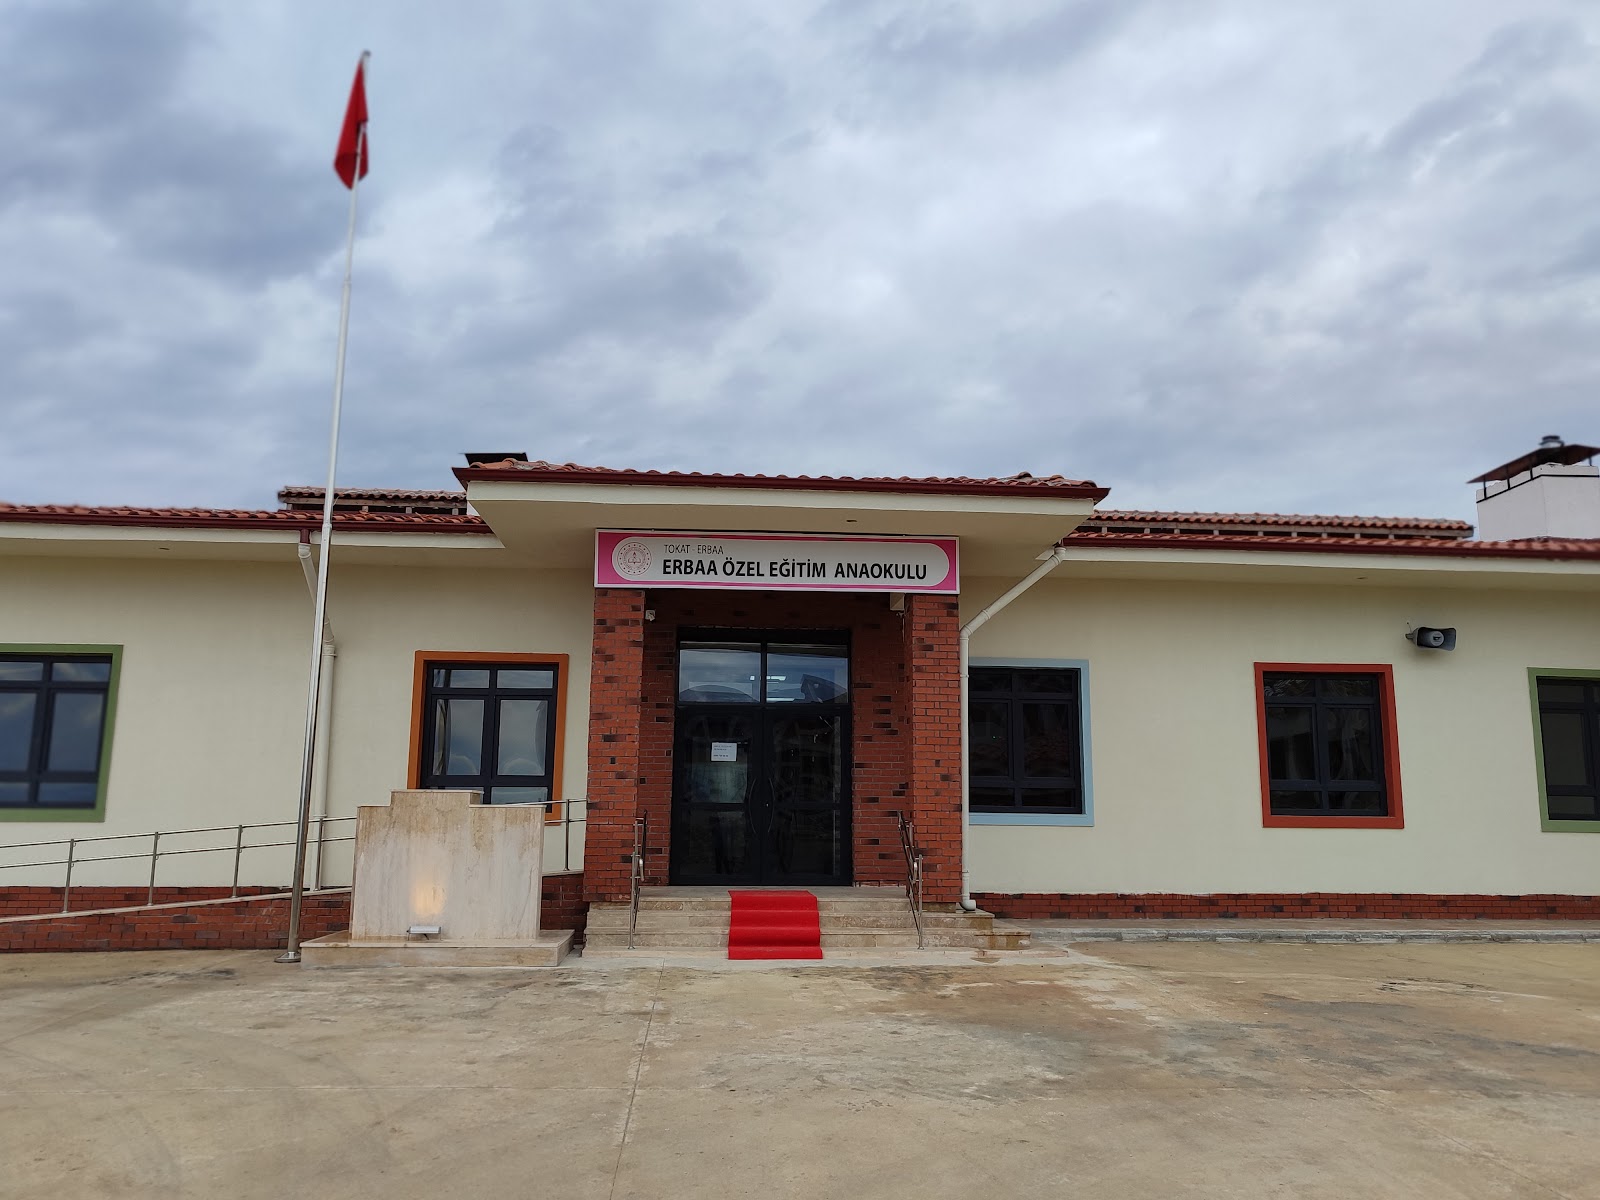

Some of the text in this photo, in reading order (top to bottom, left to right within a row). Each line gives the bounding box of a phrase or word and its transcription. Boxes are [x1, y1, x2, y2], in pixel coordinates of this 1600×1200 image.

[664, 544, 691, 554] TOKAT
[697, 544, 724, 555] ERBAA
[662, 559, 718, 576] ERBAA
[722, 557, 765, 577] ÖZEL
[769, 558, 826, 578] EĞİTİM
[834, 562, 927, 580] ANAOKULU
